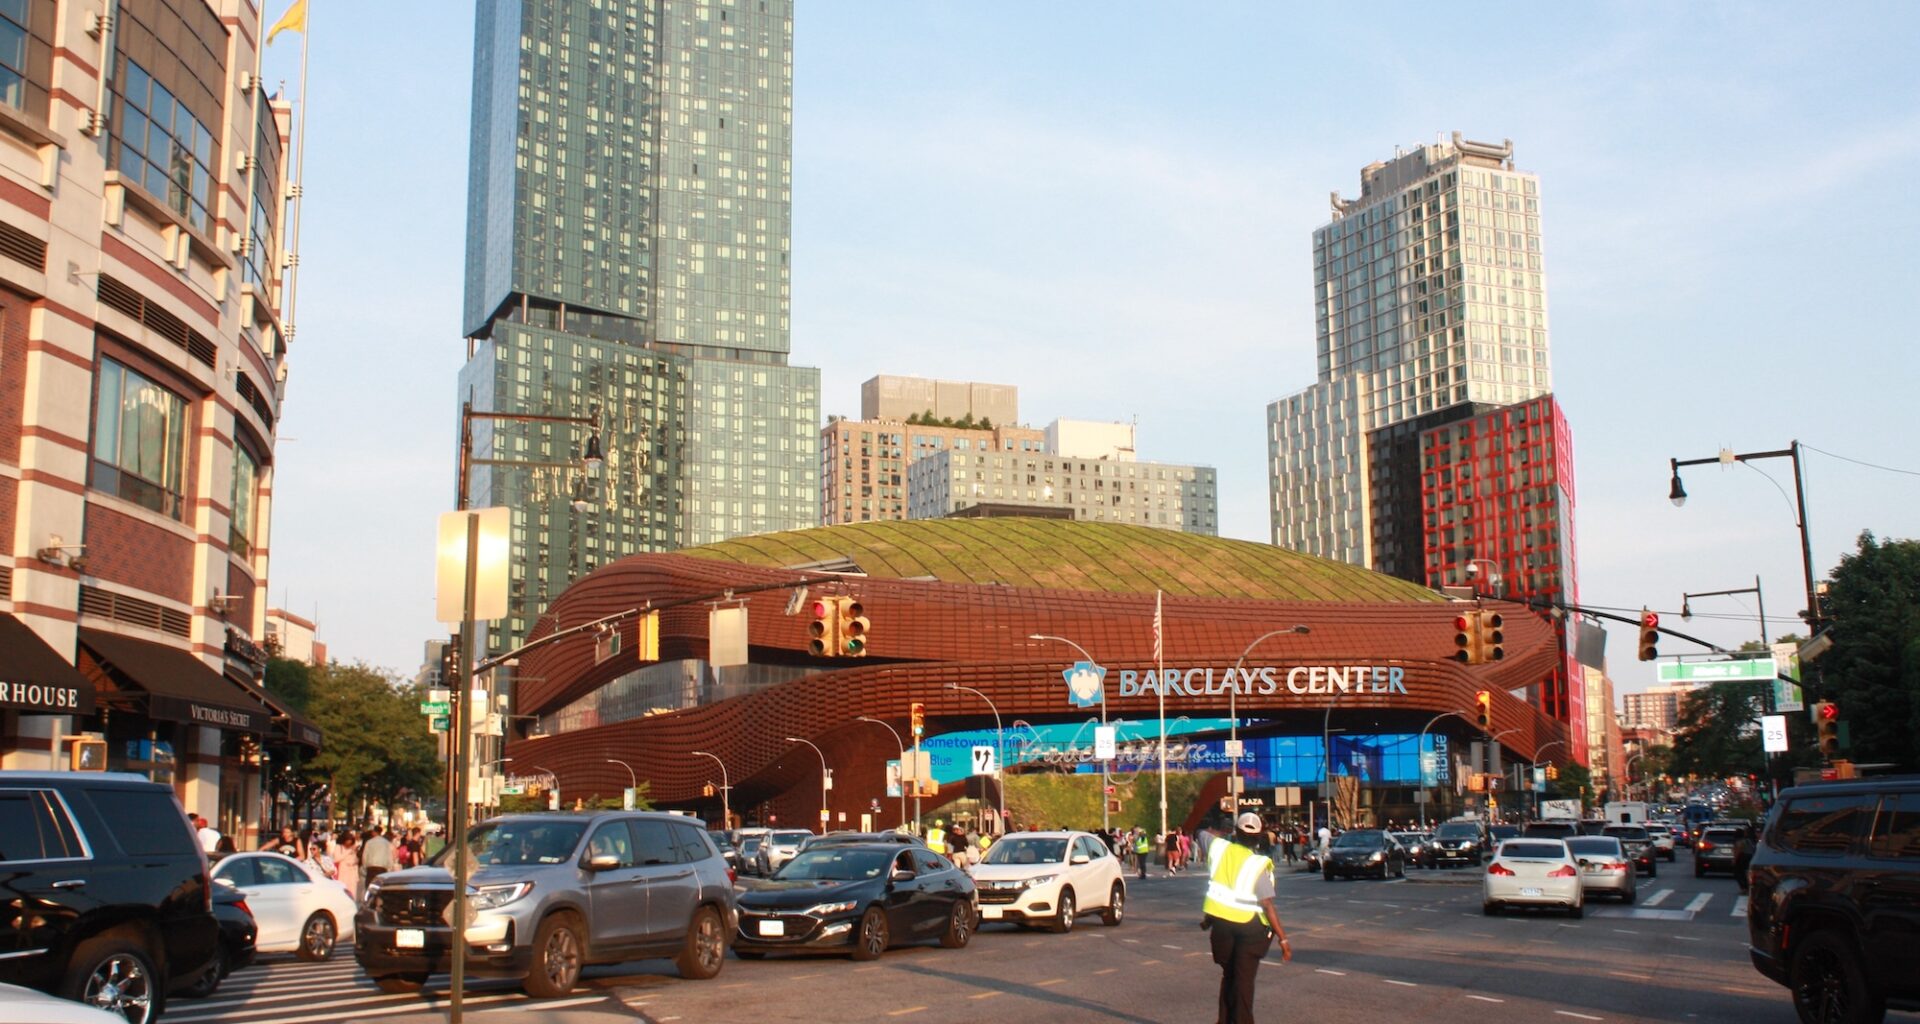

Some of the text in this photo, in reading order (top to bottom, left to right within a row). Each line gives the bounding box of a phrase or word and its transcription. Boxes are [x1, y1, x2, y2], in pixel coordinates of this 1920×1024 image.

[1119, 666, 1408, 696] BARCLAYS CENTER
[0, 681, 78, 708] RHOUSE
[191, 703, 250, 727] VICTORIA'S SECRET
[1099, 738, 1112, 748] 25
[1767, 731, 1783, 740] 25
[1239, 798, 1263, 806] PLAZA
